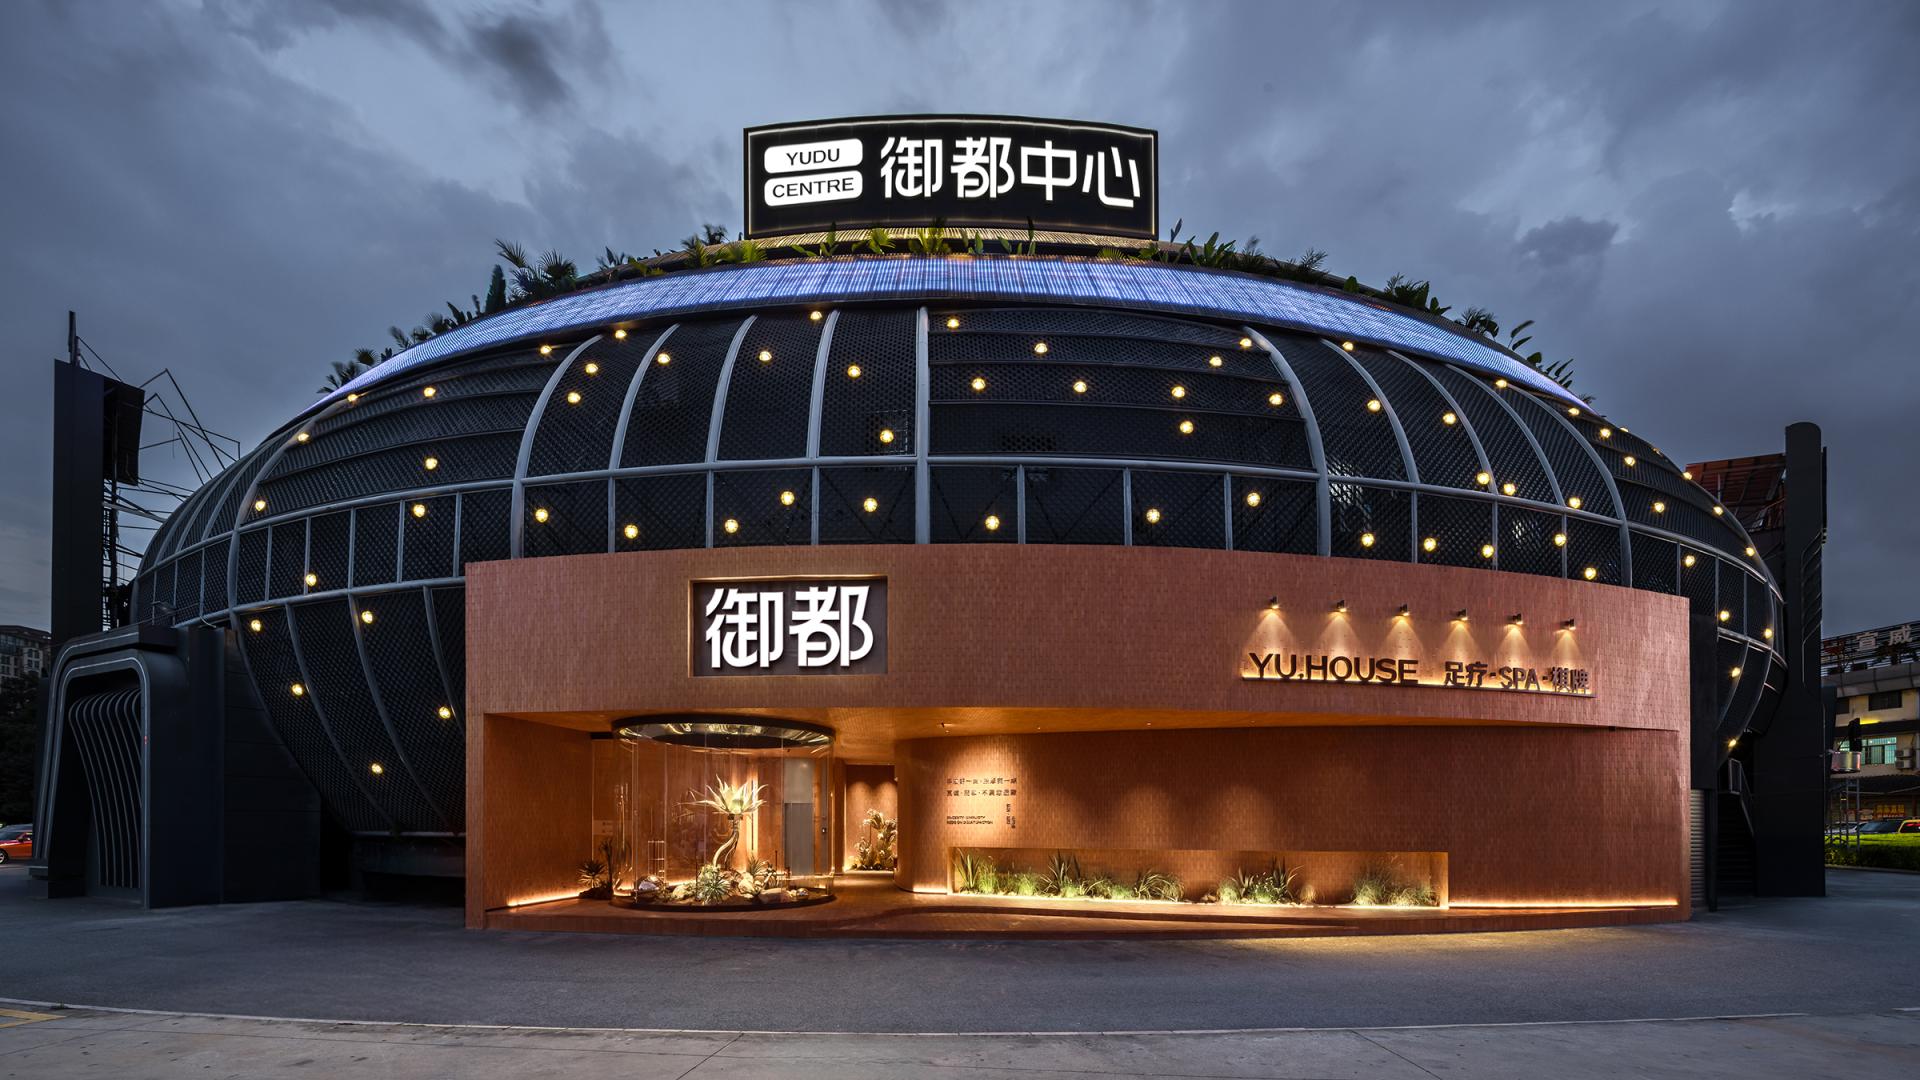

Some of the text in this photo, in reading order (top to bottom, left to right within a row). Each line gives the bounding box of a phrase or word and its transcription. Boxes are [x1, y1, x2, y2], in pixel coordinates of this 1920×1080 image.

[786, 148, 840, 166] YUDU
[880, 136, 1140, 208] 御都中心
[772, 177, 854, 198] CENTRE
[705, 586, 874, 668] 御都
[1249, 652, 1419, 685] YU.HOUSE
